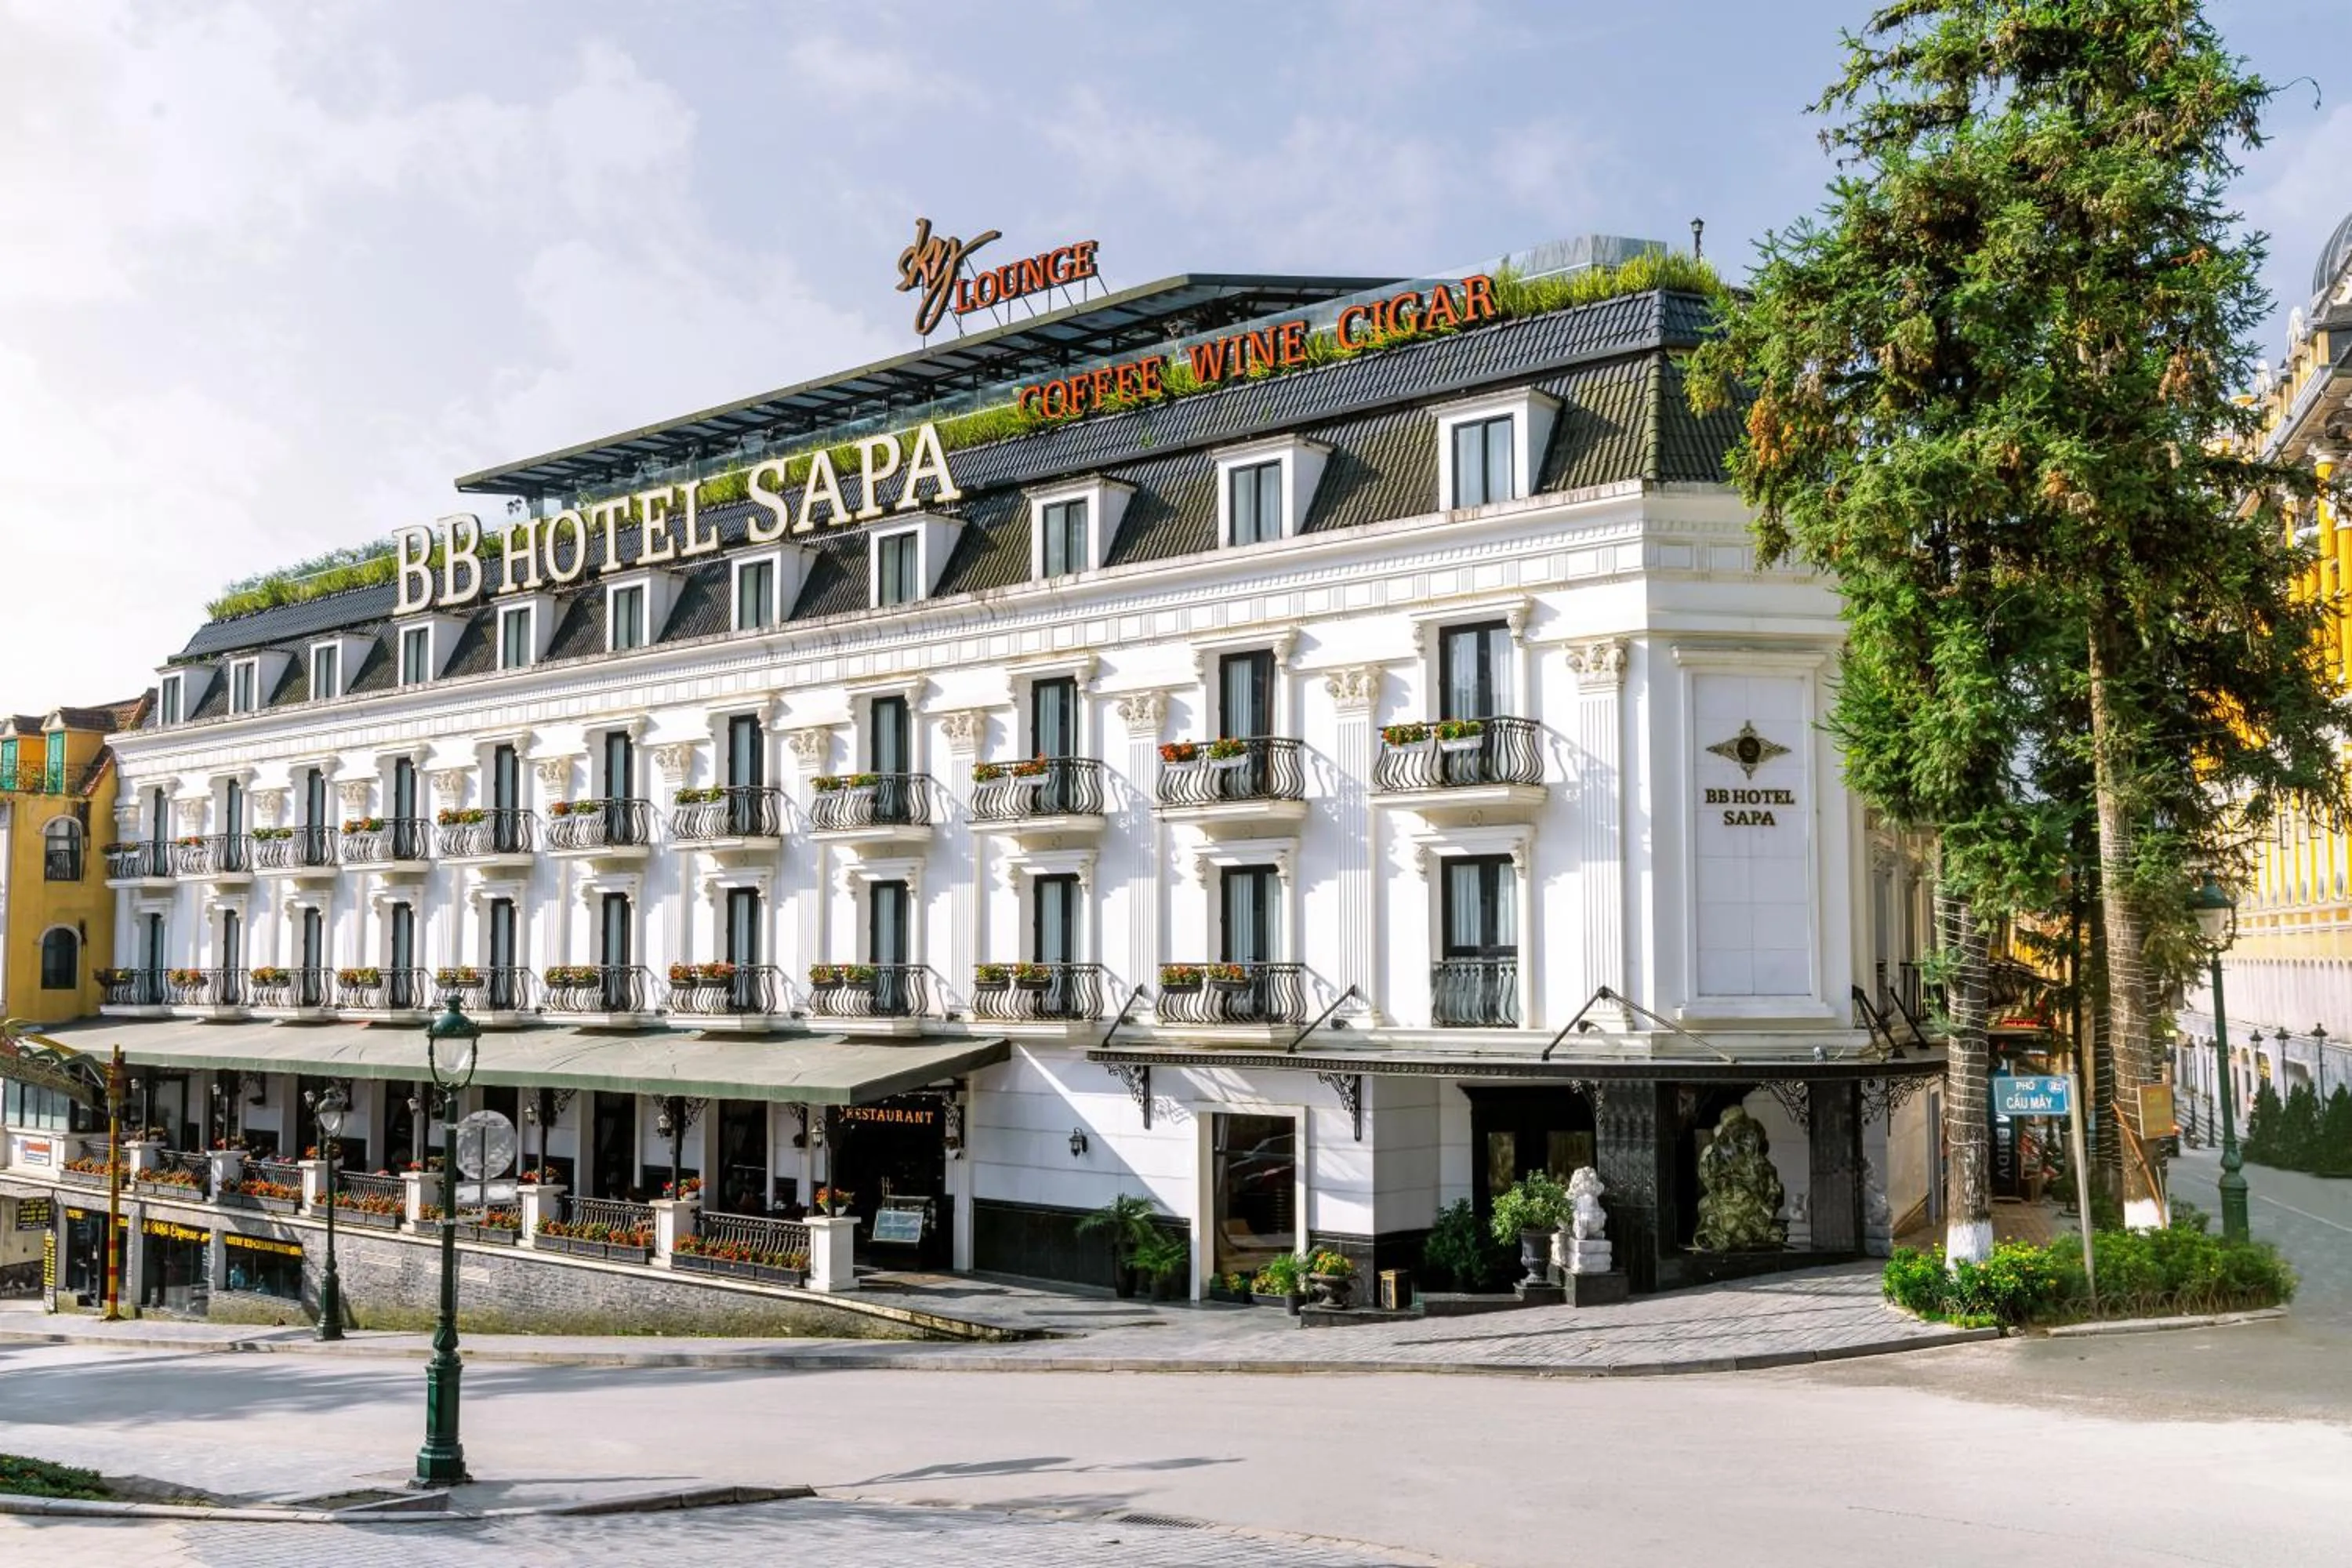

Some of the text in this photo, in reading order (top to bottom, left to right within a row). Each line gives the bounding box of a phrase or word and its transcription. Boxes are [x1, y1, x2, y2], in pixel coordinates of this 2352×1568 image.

[955, 240, 1098, 314] LOUNGE
[1018, 274, 1498, 419] COFFEE WINE CIGAR
[392, 423, 962, 615] BB HOTEL SAPA
[1705, 789, 1795, 804] BB HOTEL
[1724, 811, 1776, 826] SAPA
[846, 1107, 933, 1124] RESTAURANT
